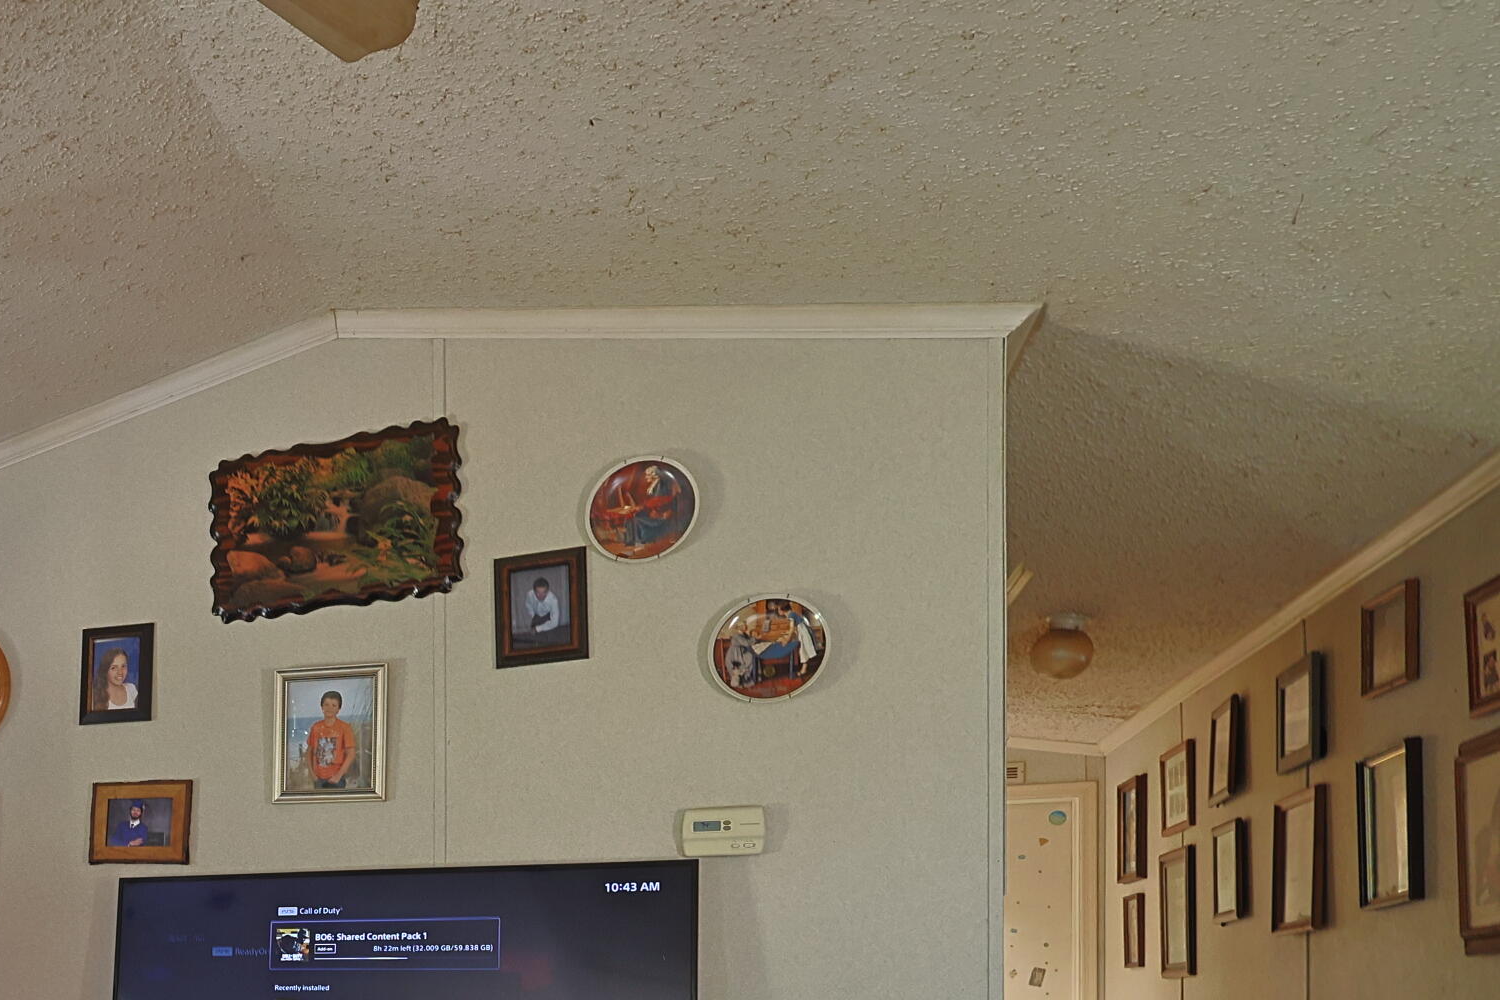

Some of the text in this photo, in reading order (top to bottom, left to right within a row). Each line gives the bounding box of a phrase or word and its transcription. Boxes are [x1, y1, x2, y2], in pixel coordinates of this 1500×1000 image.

[605, 881, 660, 892] 10:43 AM
[299, 907, 313, 915] Call
[315, 933, 335, 941] BO6:
[336, 933, 365, 941] Shared
[366, 932, 400, 941] Content
[401, 932, 421, 941] Pack
[400, 944, 412, 952] left
[274, 984, 301, 992] Recently
